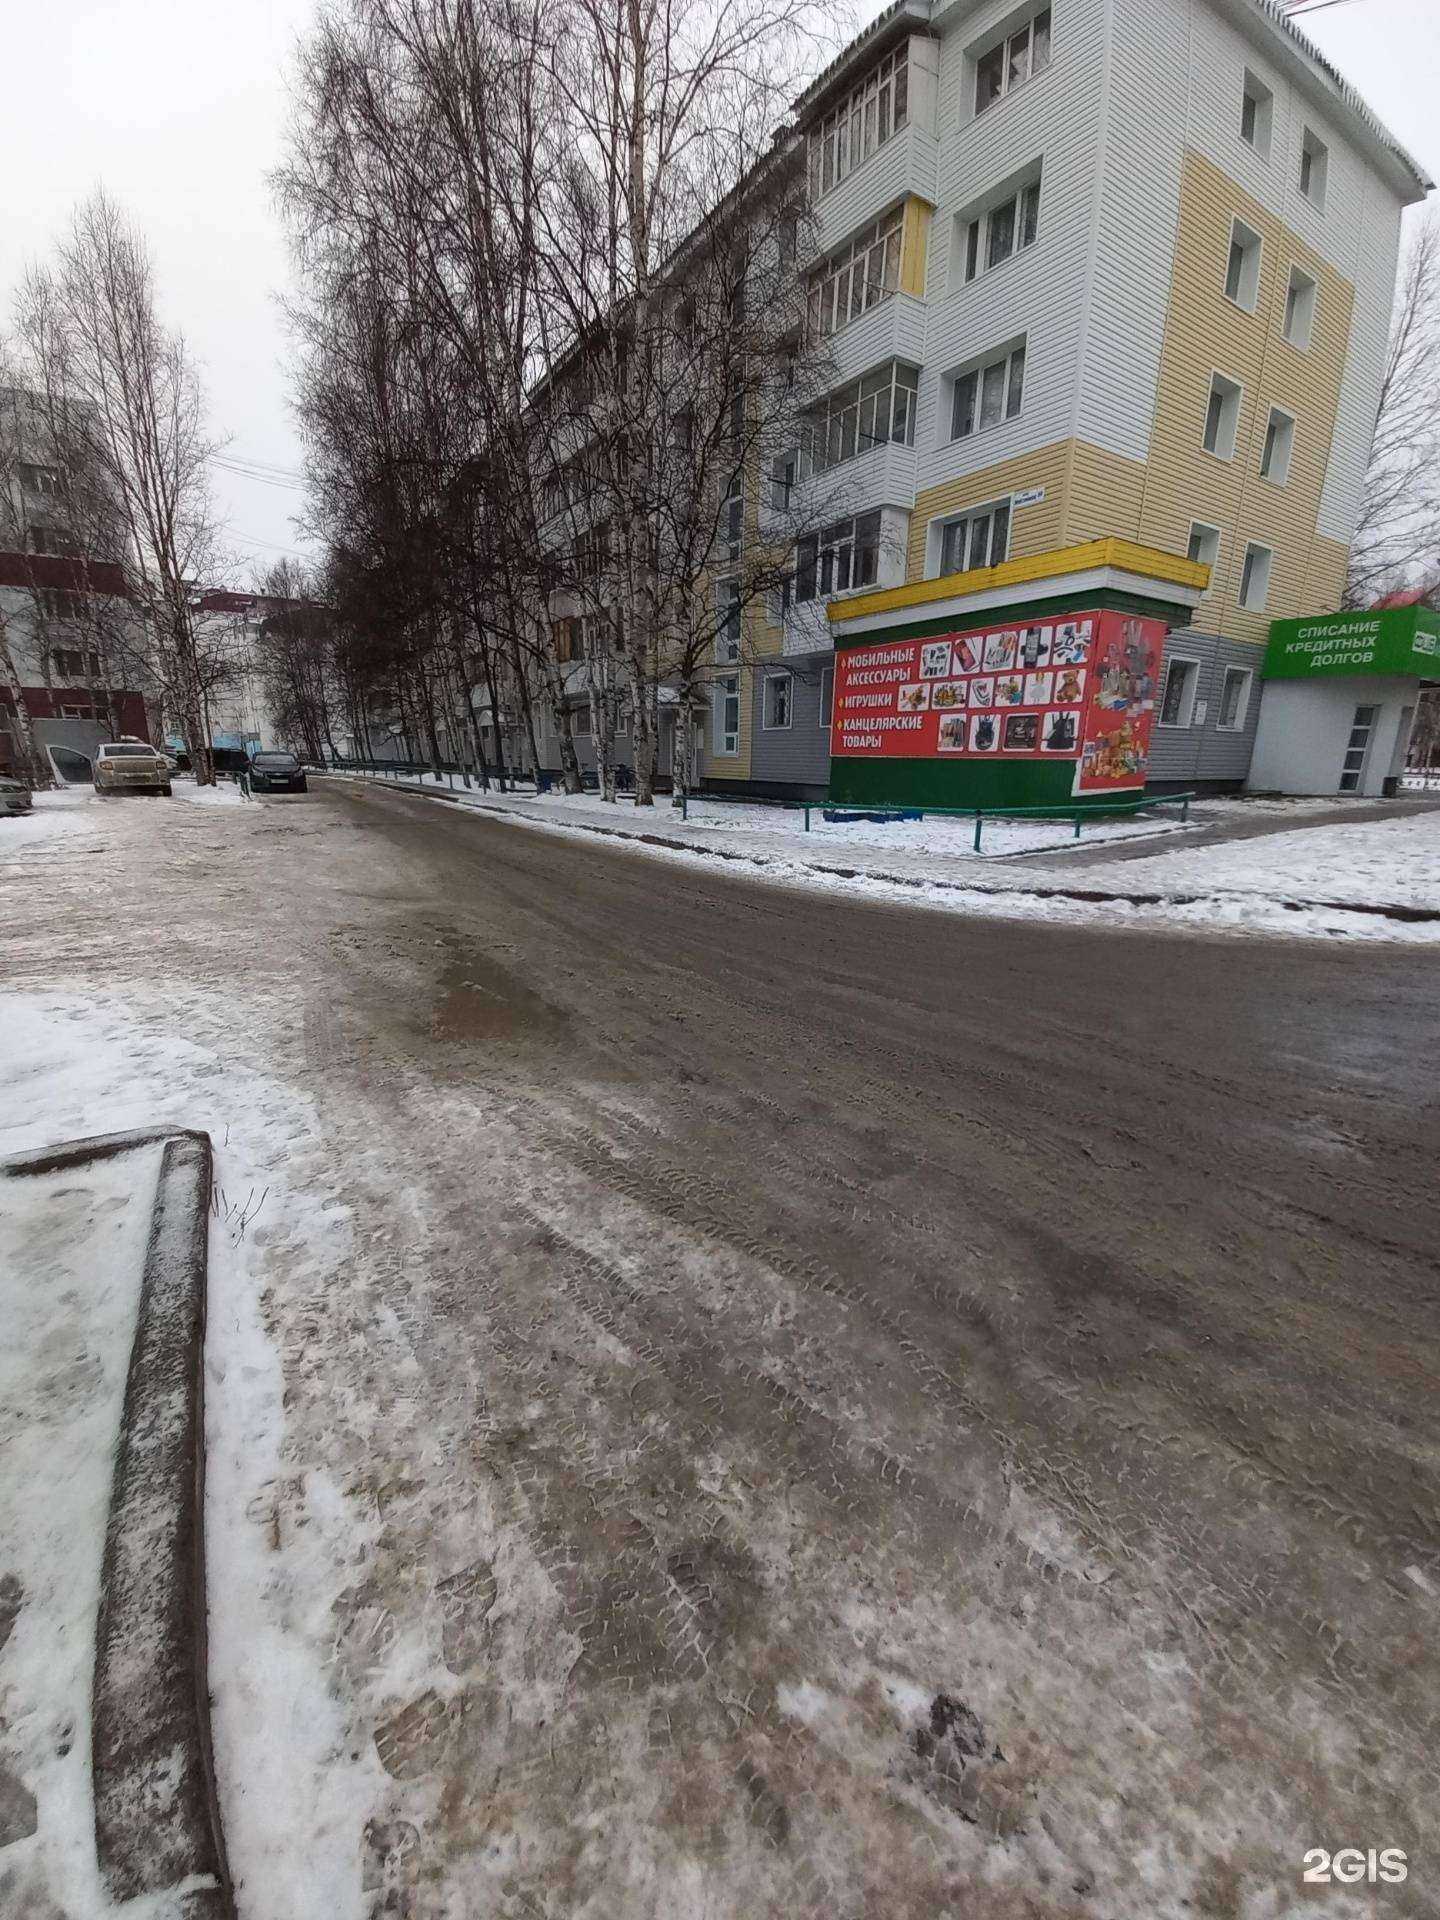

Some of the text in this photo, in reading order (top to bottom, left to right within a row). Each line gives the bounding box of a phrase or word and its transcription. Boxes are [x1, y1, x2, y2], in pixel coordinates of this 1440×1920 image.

[1297, 621, 1380, 638] СПИСАНИЕ
[1285, 636, 1376, 653] КРЕДИТНЫХ
[848, 648, 915, 668] МОБИЛЬНЫЕ
[1310, 652, 1373, 667] ДОЛГОВ
[846, 668, 910, 685] АКСЕССУАРЫ
[845, 694, 892, 708] ИГРУШКИ
[843, 716, 922, 732] КАНЦЕЛЯРСКИЕ
[842, 735, 881, 747] ТОВАРЫ
